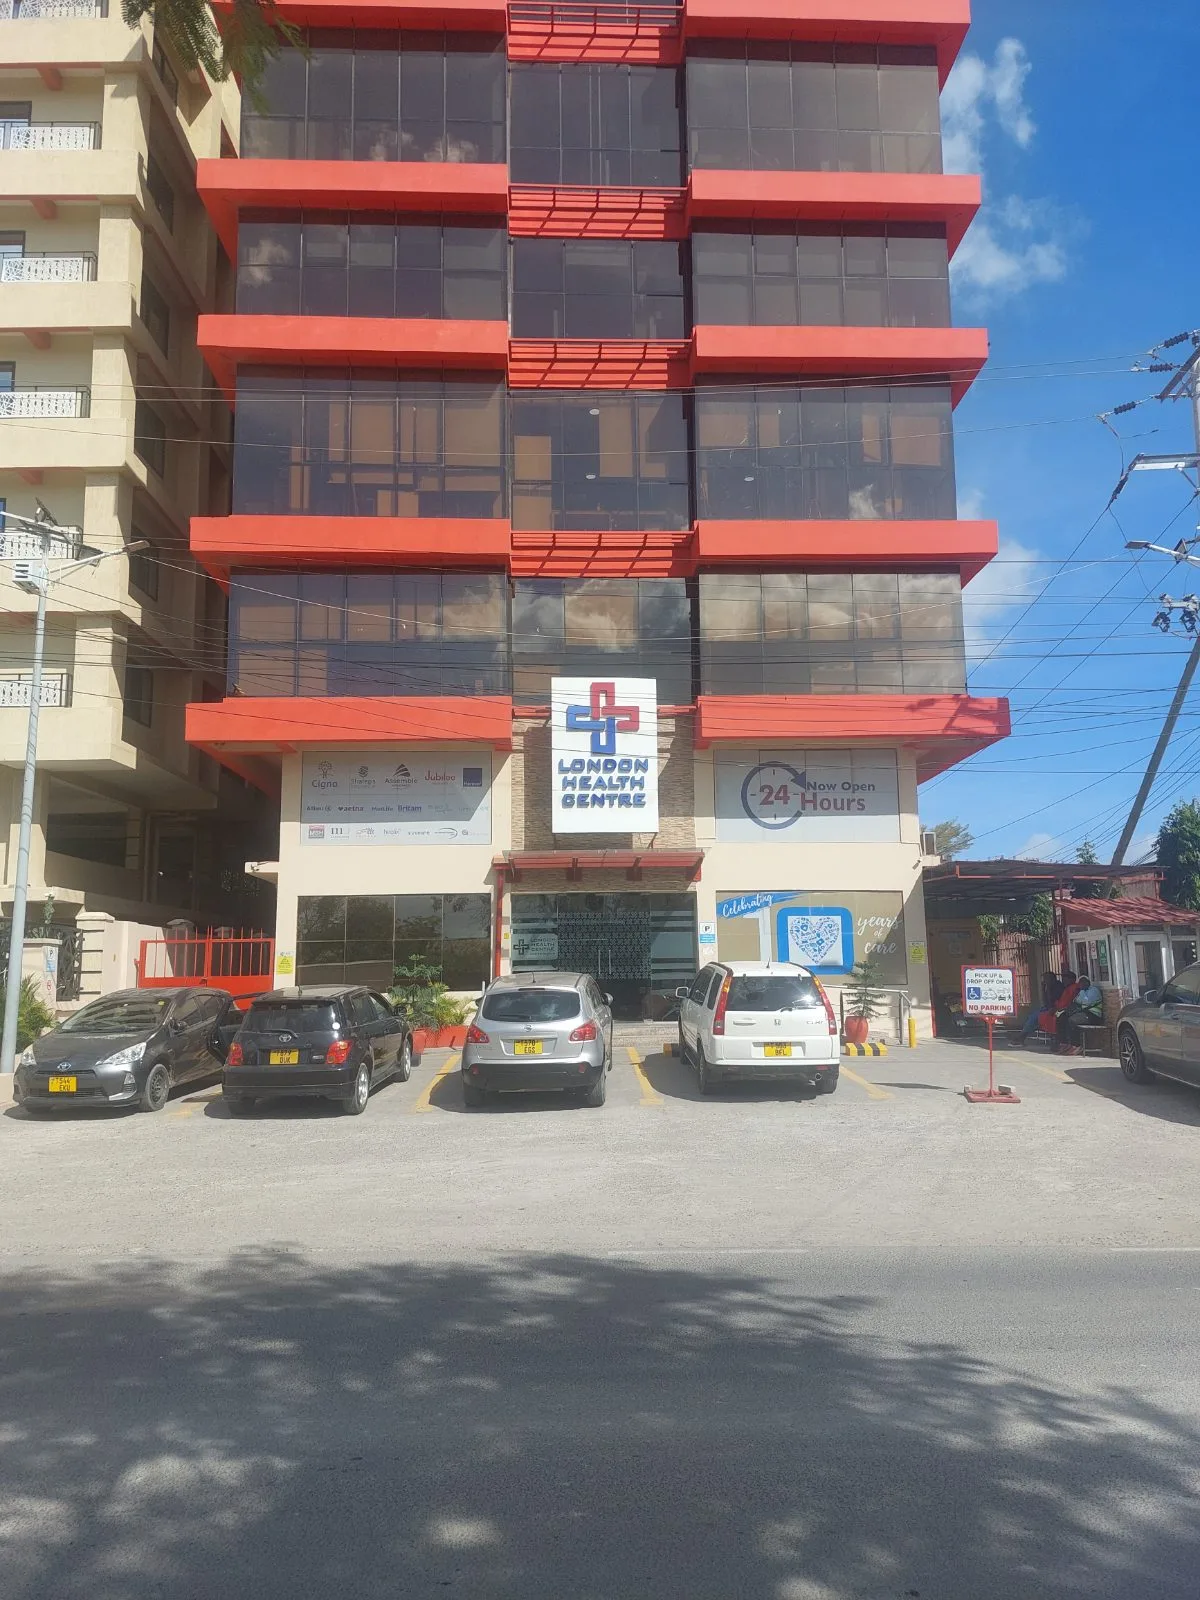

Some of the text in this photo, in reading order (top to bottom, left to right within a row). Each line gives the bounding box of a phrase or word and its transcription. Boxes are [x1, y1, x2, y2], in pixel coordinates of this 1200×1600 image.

[558, 758, 649, 774] LONDON
[561, 776, 645, 791] HEALTH
[807, 782, 876, 793] Now Open
[561, 793, 647, 808] CENTRE
[759, 785, 866, 811] 24 Hours
[722, 893, 773, 917] Celebrating
[857, 916, 902, 936] years
[864, 942, 897, 954] care
